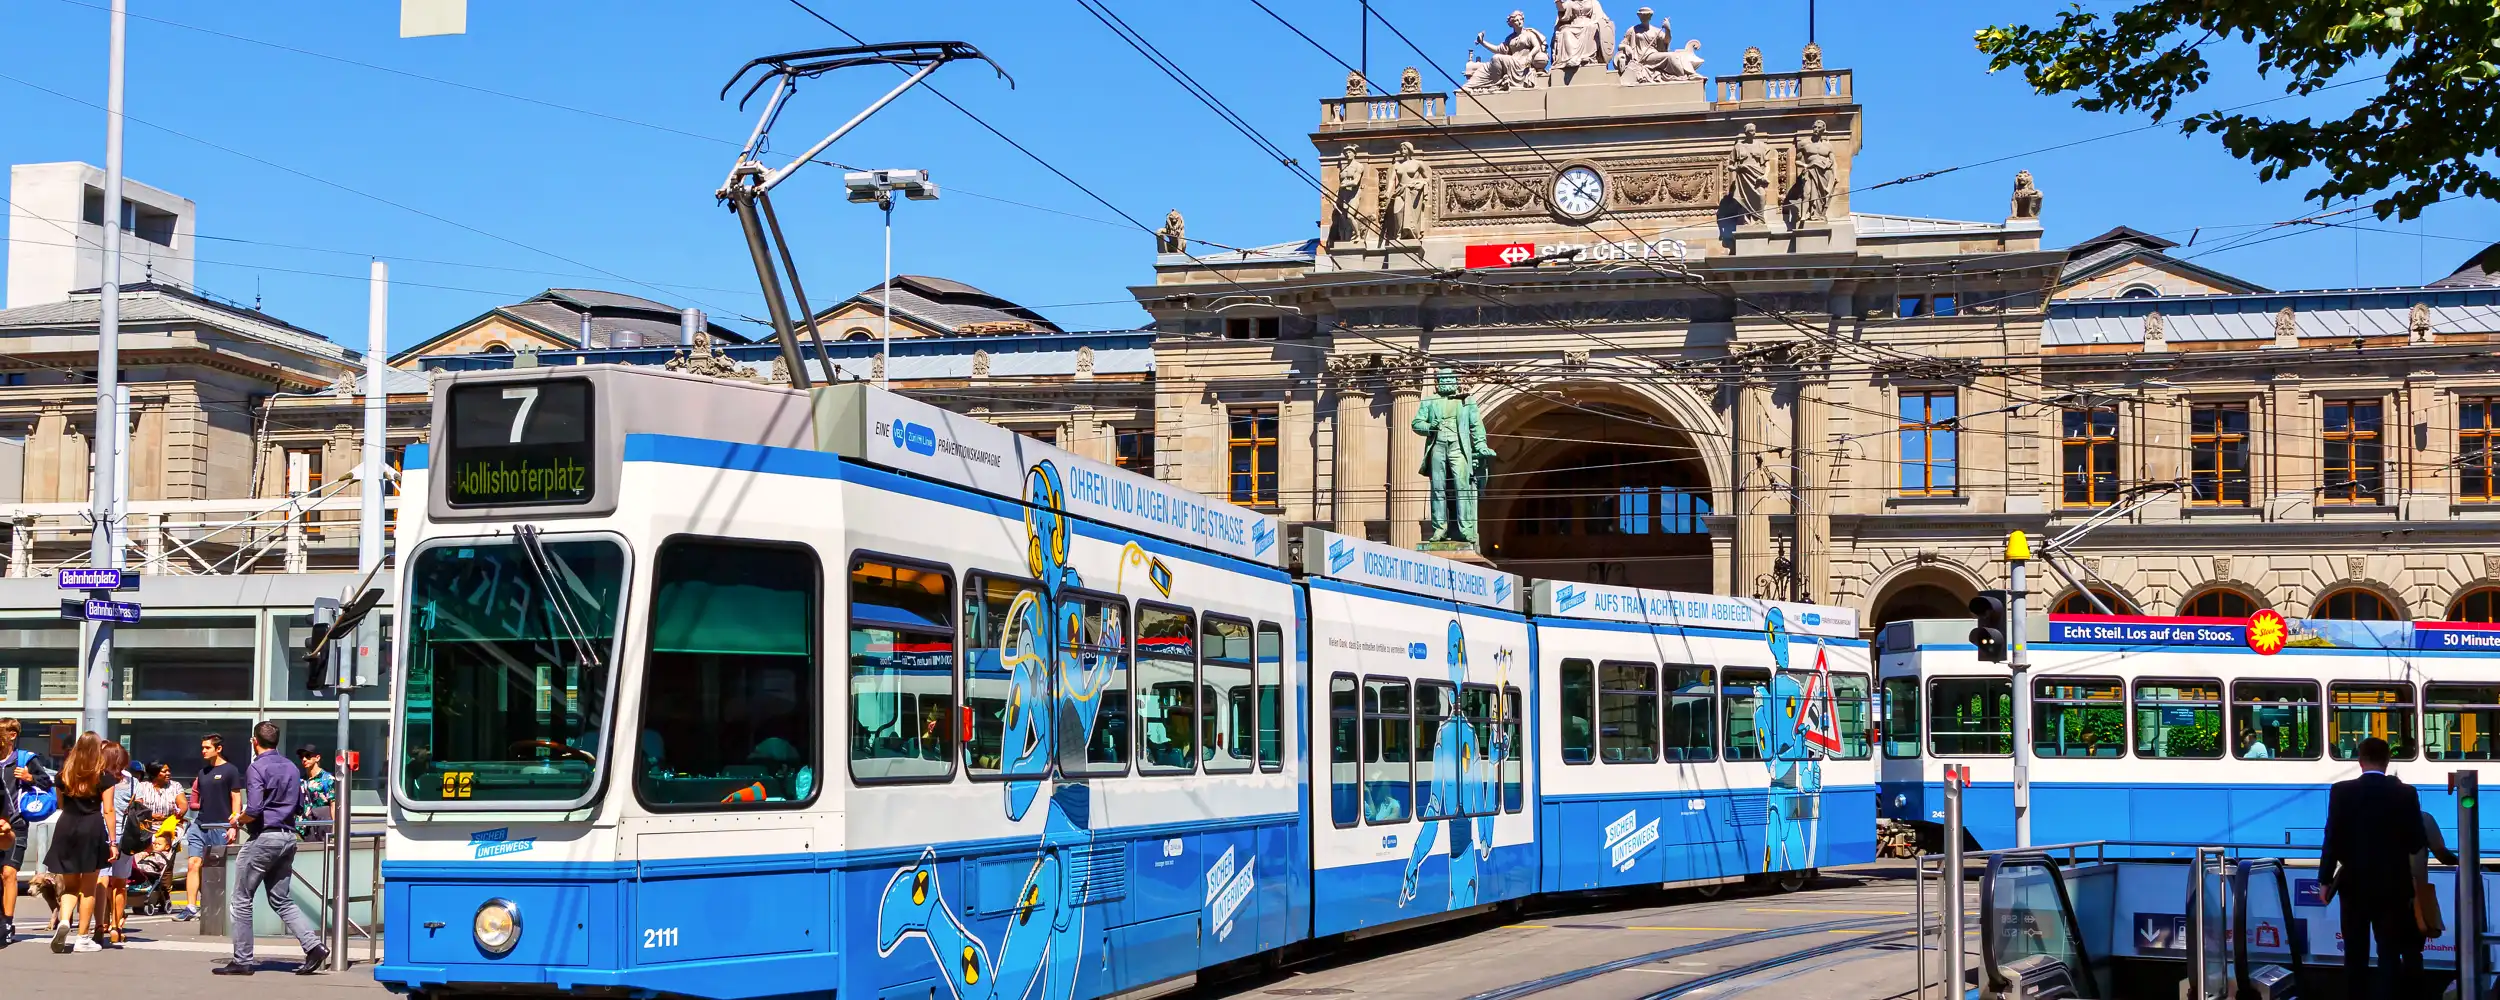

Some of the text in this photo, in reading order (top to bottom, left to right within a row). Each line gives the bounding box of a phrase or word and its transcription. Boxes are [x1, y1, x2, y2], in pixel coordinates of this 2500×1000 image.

[502, 387, 539, 443] 7
[875, 422, 890, 438] EINE
[457, 457, 585, 499] Wollishoferplatz
[1070, 466, 1246, 546] OHREN UND AUGEN AUF DIE STRASSE.
[62, 571, 117, 587] Bahnhofplatz
[1363, 552, 1398, 578] VORSICHT
[1400, 559, 1412, 582] MIT
[1414, 563, 1428, 586] DEM
[1429, 566, 1446, 589] VELO
[1447, 569, 1457, 592] BEI
[1458, 572, 1488, 597] SCHIENEN.
[88, 602, 139, 619] Bahnhofstrasse
[1594, 592, 1754, 623] AUFS TRAM ACHTEN BEIM ABBIEGEN.
[2064, 626, 2234, 641] Echt Steil. Los auf den Stoos.
[2444, 634, 2459, 645] 50
[445, 776, 471, 793] 02
[475, 829, 506, 843] SICHER
[1610, 815, 1634, 842] SICHER
[478, 840, 530, 858] UNTERWEGS
[1615, 825, 1655, 862] UNTERWEGS
[1210, 852, 1232, 894] SICHER
[1216, 867, 1251, 927] UNTERWEGS
[643, 928, 678, 948] 2111
